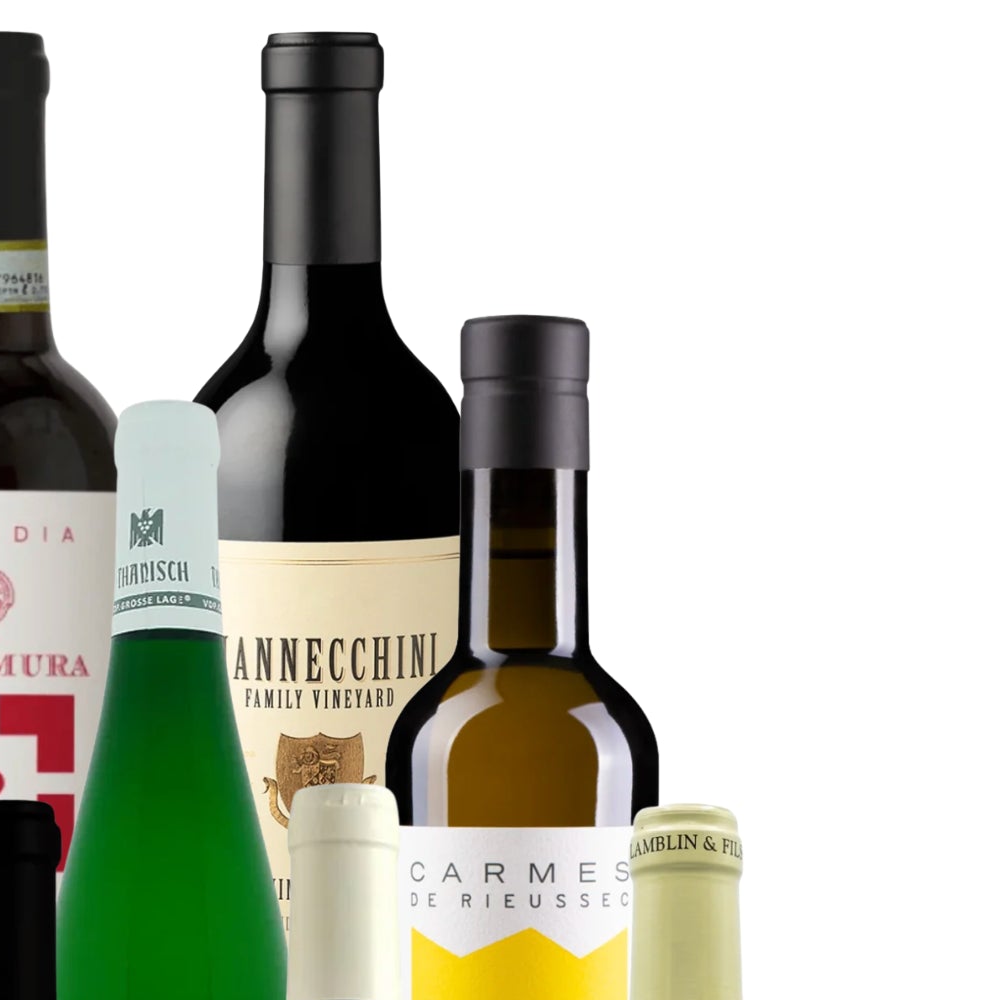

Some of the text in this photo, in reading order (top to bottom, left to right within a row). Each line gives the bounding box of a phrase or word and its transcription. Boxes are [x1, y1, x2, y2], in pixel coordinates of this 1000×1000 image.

[245, 688, 395, 709] FAMILY VINEYARD
[630, 834, 699, 859] LAMBLIN
[703, 836, 718, 852] &
[410, 861, 629, 884] CARMES
[410, 893, 629, 909] DE RIEUSSEC
